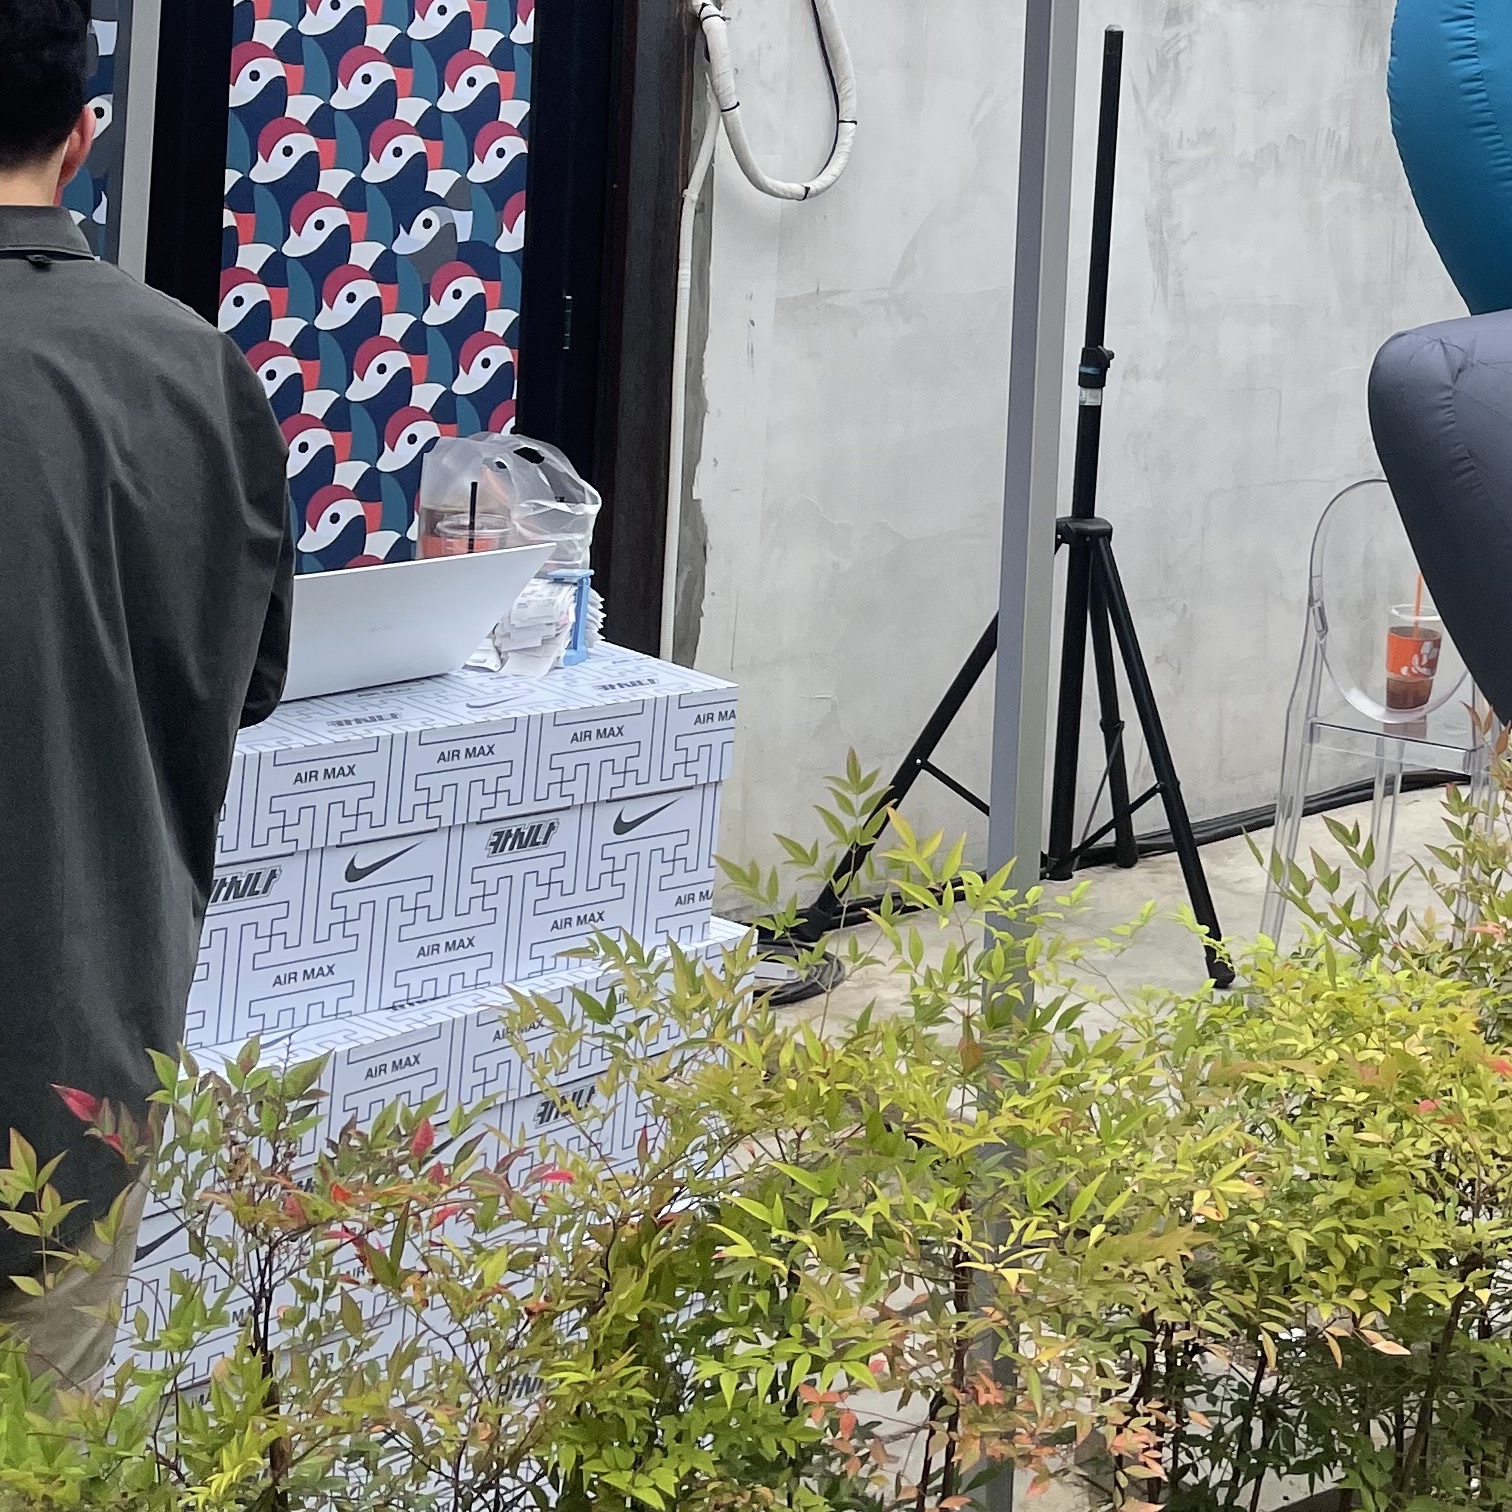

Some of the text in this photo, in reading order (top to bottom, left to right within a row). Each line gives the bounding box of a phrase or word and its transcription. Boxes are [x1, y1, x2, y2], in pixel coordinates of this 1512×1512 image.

[693, 708, 737, 726] AIR MA
[569, 724, 625, 744] AIR MAX
[436, 743, 496, 764] AIR MAX
[292, 763, 357, 786] AIR MAX
[674, 892, 696, 908] AIR
[550, 910, 606, 932] AIR MAX
[416, 936, 476, 959] AIR MAX
[272, 963, 336, 988] AIR MAX
[364, 1053, 421, 1081] AIR MAX
